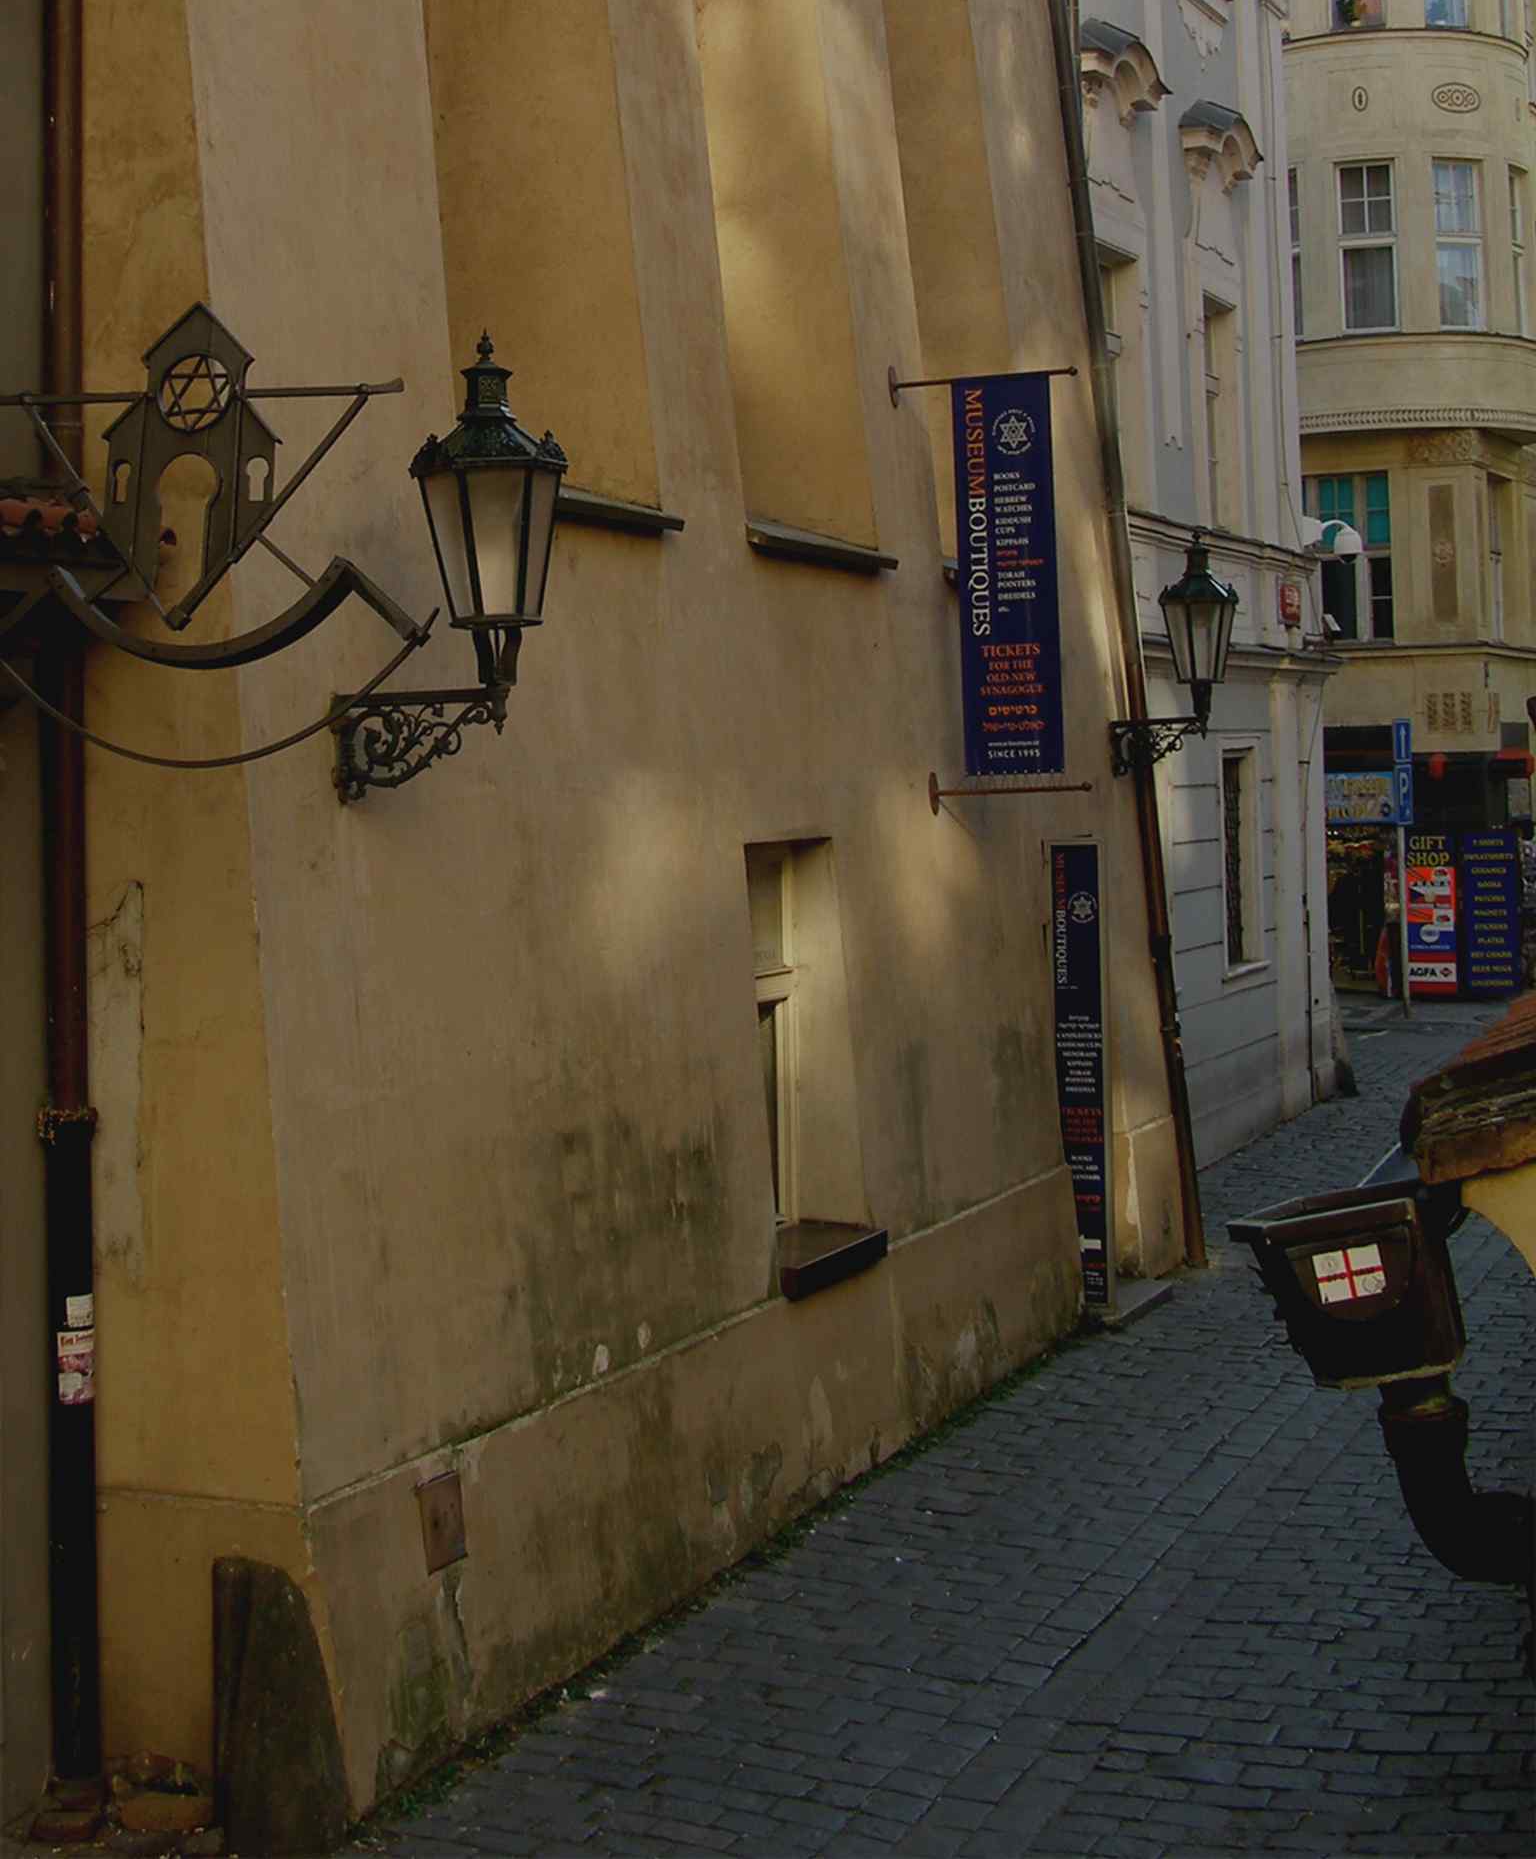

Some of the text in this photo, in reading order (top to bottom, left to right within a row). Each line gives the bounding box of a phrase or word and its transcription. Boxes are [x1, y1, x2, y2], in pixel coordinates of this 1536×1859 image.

[997, 579, 1037, 589] POINTERS
[980, 643, 1041, 658] TICKETS
[988, 659, 1033, 670] FOR THE
[987, 749, 1016, 759] SINCE
[1399, 771, 1409, 807] P
[1409, 836, 1446, 851] GIFT
[1407, 851, 1451, 867] SHOP
[1410, 967, 1437, 978] AGFA
